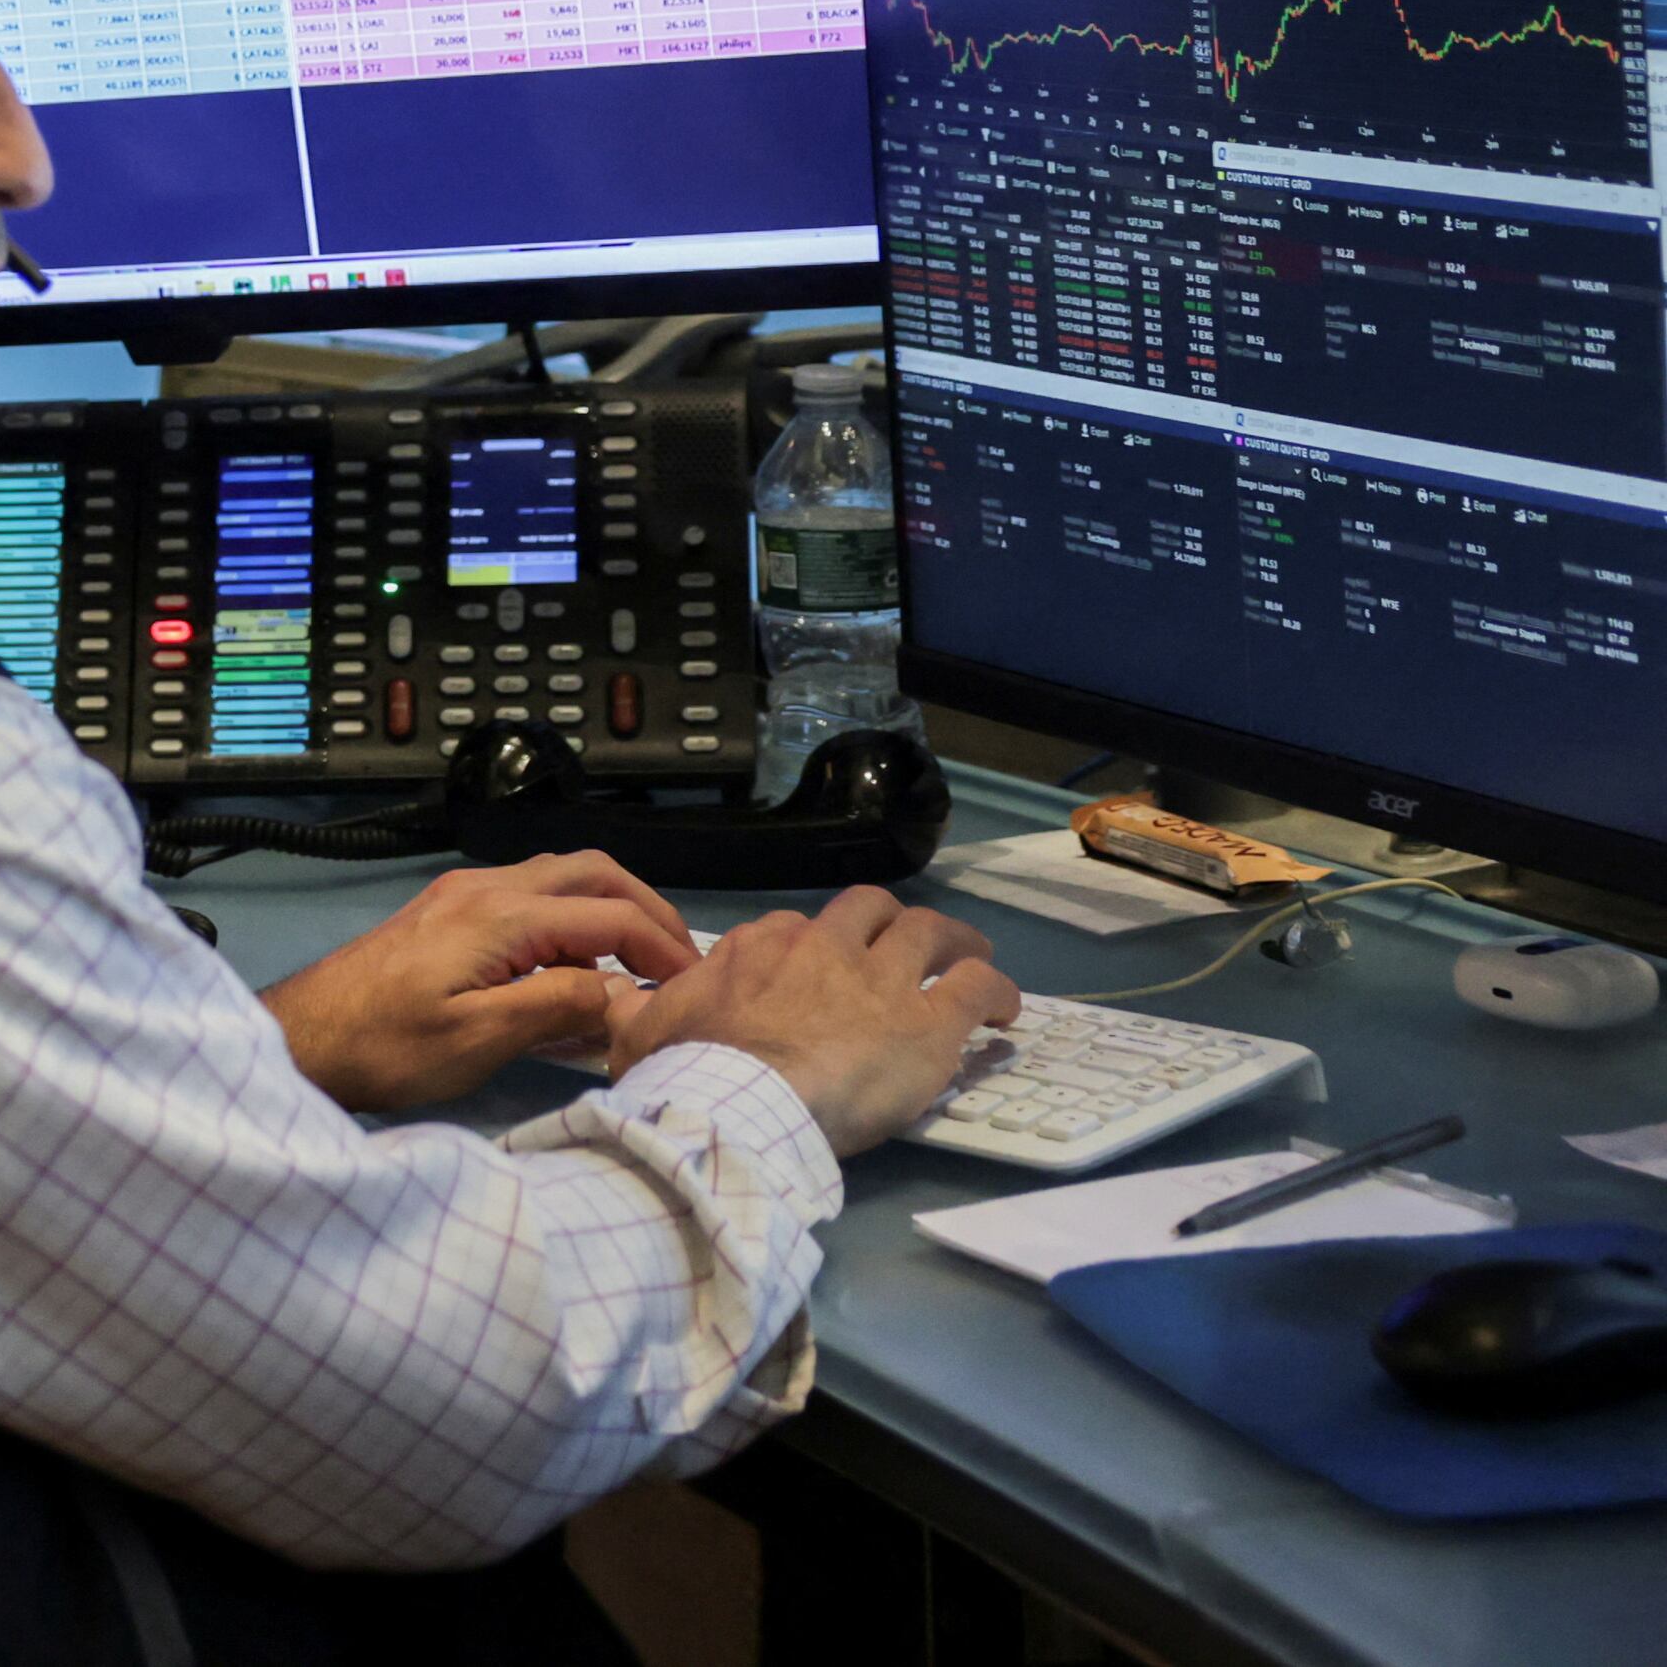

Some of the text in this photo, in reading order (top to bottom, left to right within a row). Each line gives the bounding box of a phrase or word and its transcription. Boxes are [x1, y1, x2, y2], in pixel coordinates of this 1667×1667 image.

[1226, 171, 1312, 191] CUSTOM QUOTE GRID
[1244, 437, 1330, 462] CUSTOM QUOTE GRID
[1368, 789, 1420, 819] acer
